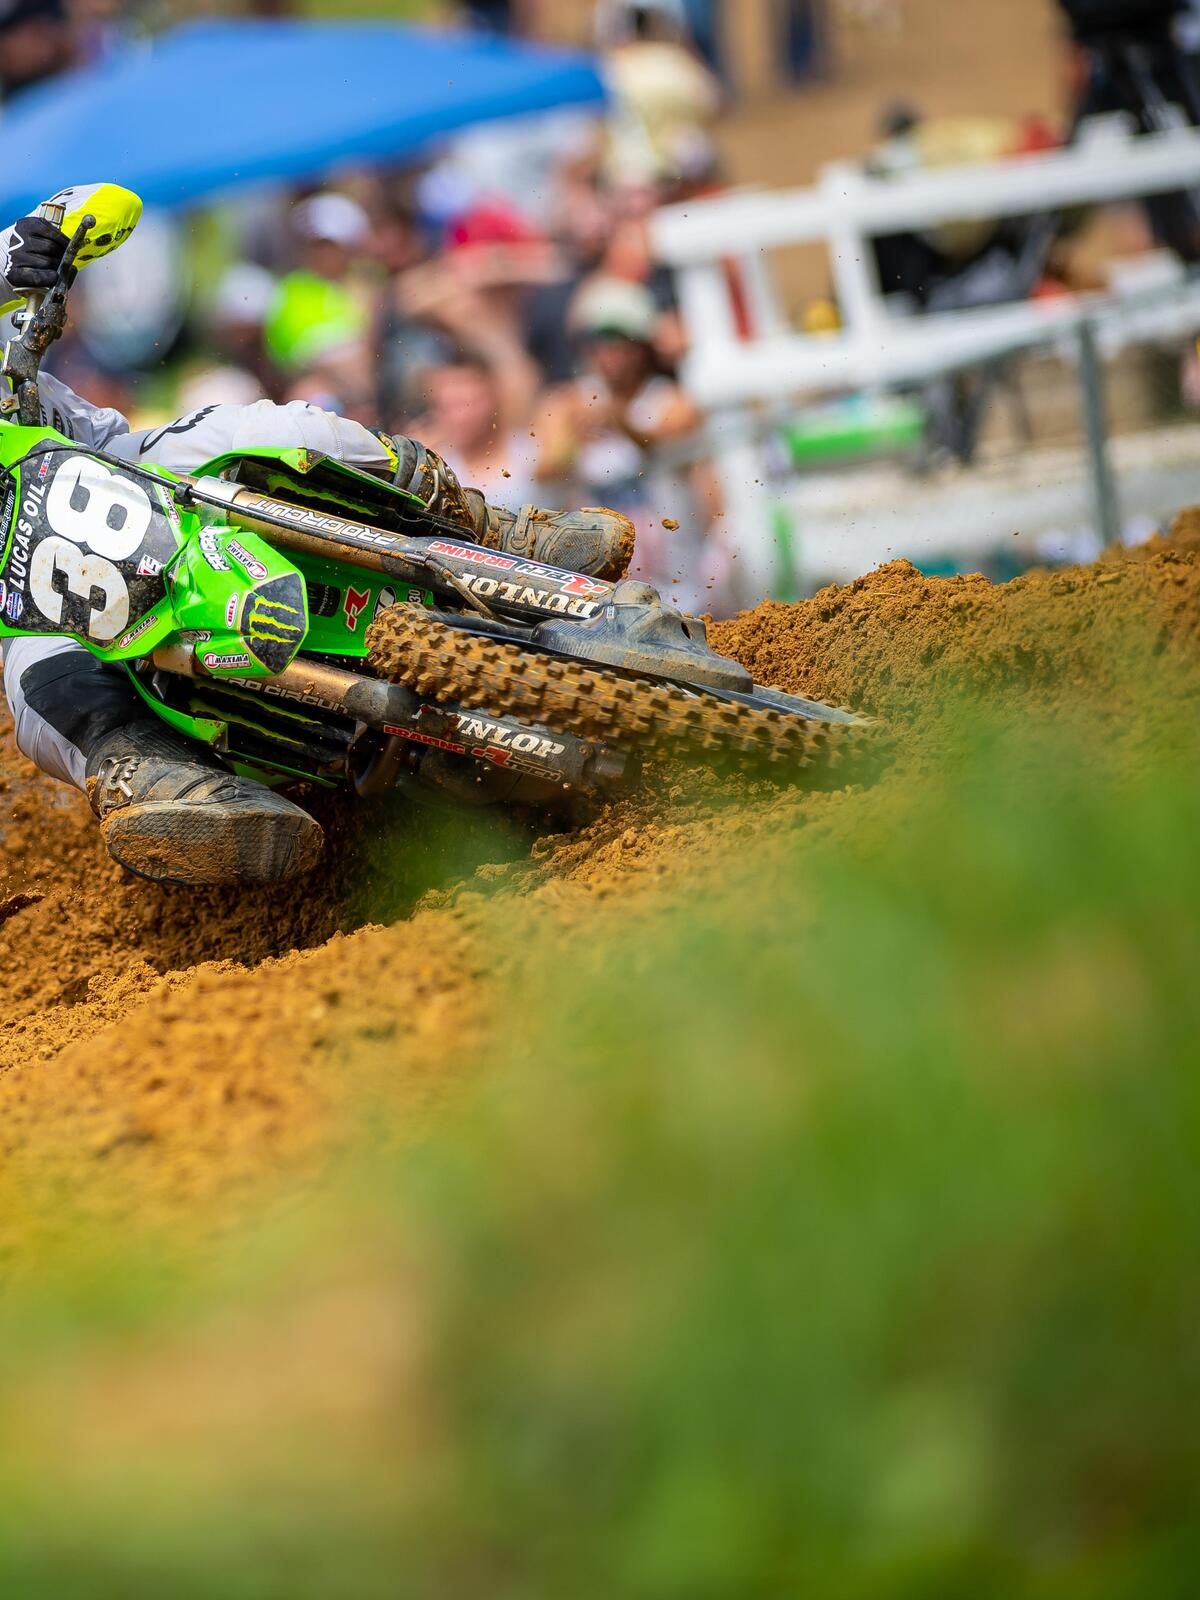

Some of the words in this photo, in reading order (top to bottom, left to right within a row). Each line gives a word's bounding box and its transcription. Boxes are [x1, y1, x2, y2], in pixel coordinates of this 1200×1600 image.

[246, 499, 346, 532] CIRCUIT
[9, 520, 33, 591] LUCAS
[23, 482, 47, 517] OIL
[30, 456, 152, 641] 38
[345, 522, 401, 546] PRO
[427, 541, 517, 571] BRAKING
[263, 684, 348, 714] CIRCUIT
[384, 724, 465, 755] BRAKING
